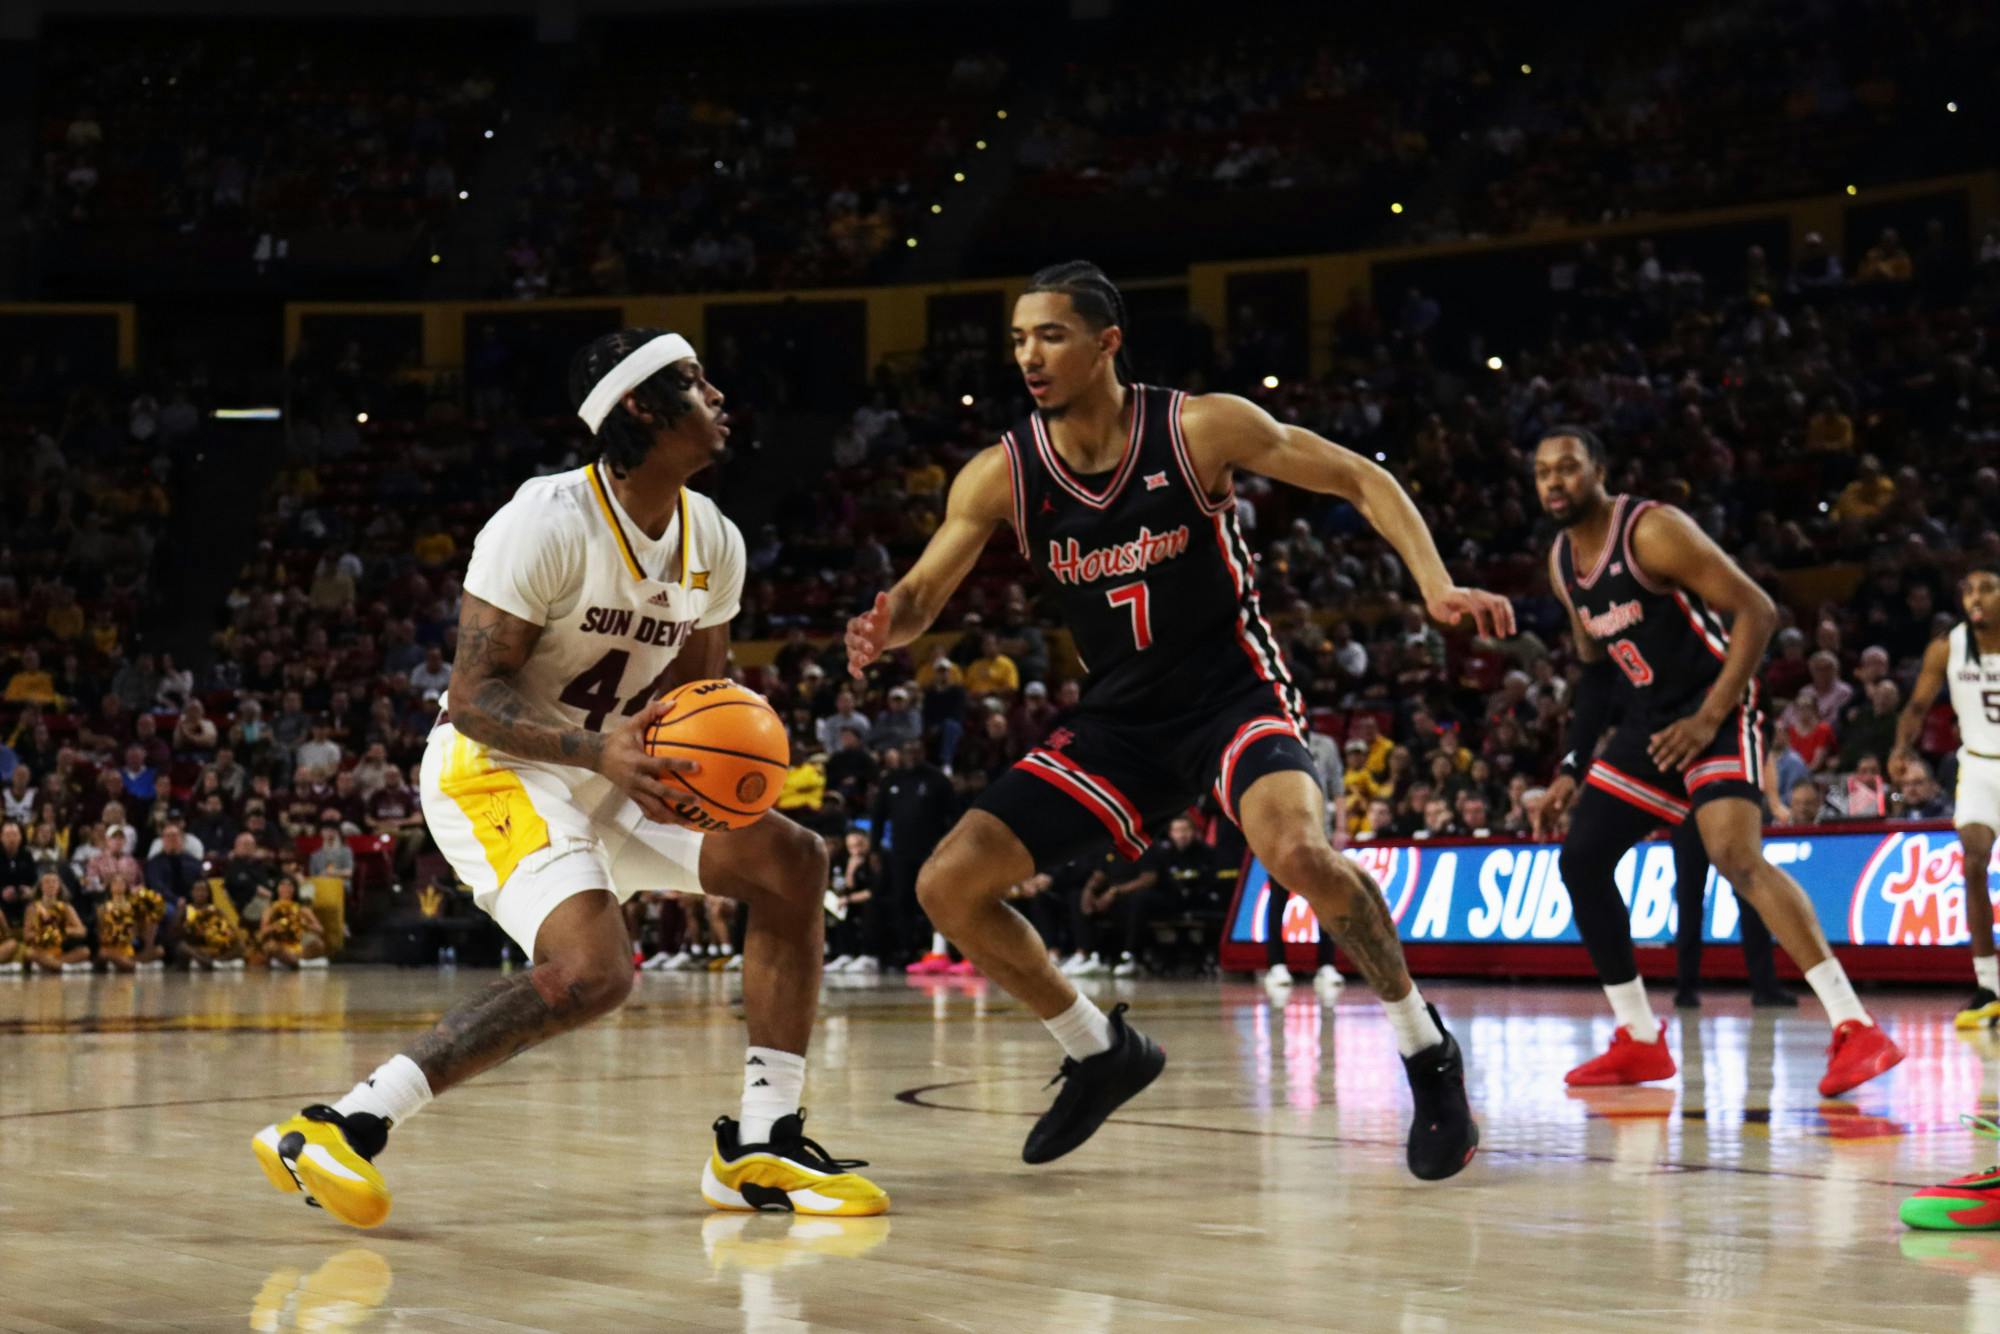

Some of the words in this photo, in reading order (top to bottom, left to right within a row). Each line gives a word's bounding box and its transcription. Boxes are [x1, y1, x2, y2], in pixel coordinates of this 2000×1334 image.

[1048, 524, 1190, 585] Houston
[579, 606, 633, 637] SUN
[1105, 580, 1153, 651] 7
[1607, 639, 1654, 687] 13
[1410, 851, 1458, 939] A
[1467, 847, 1573, 939] SUB
